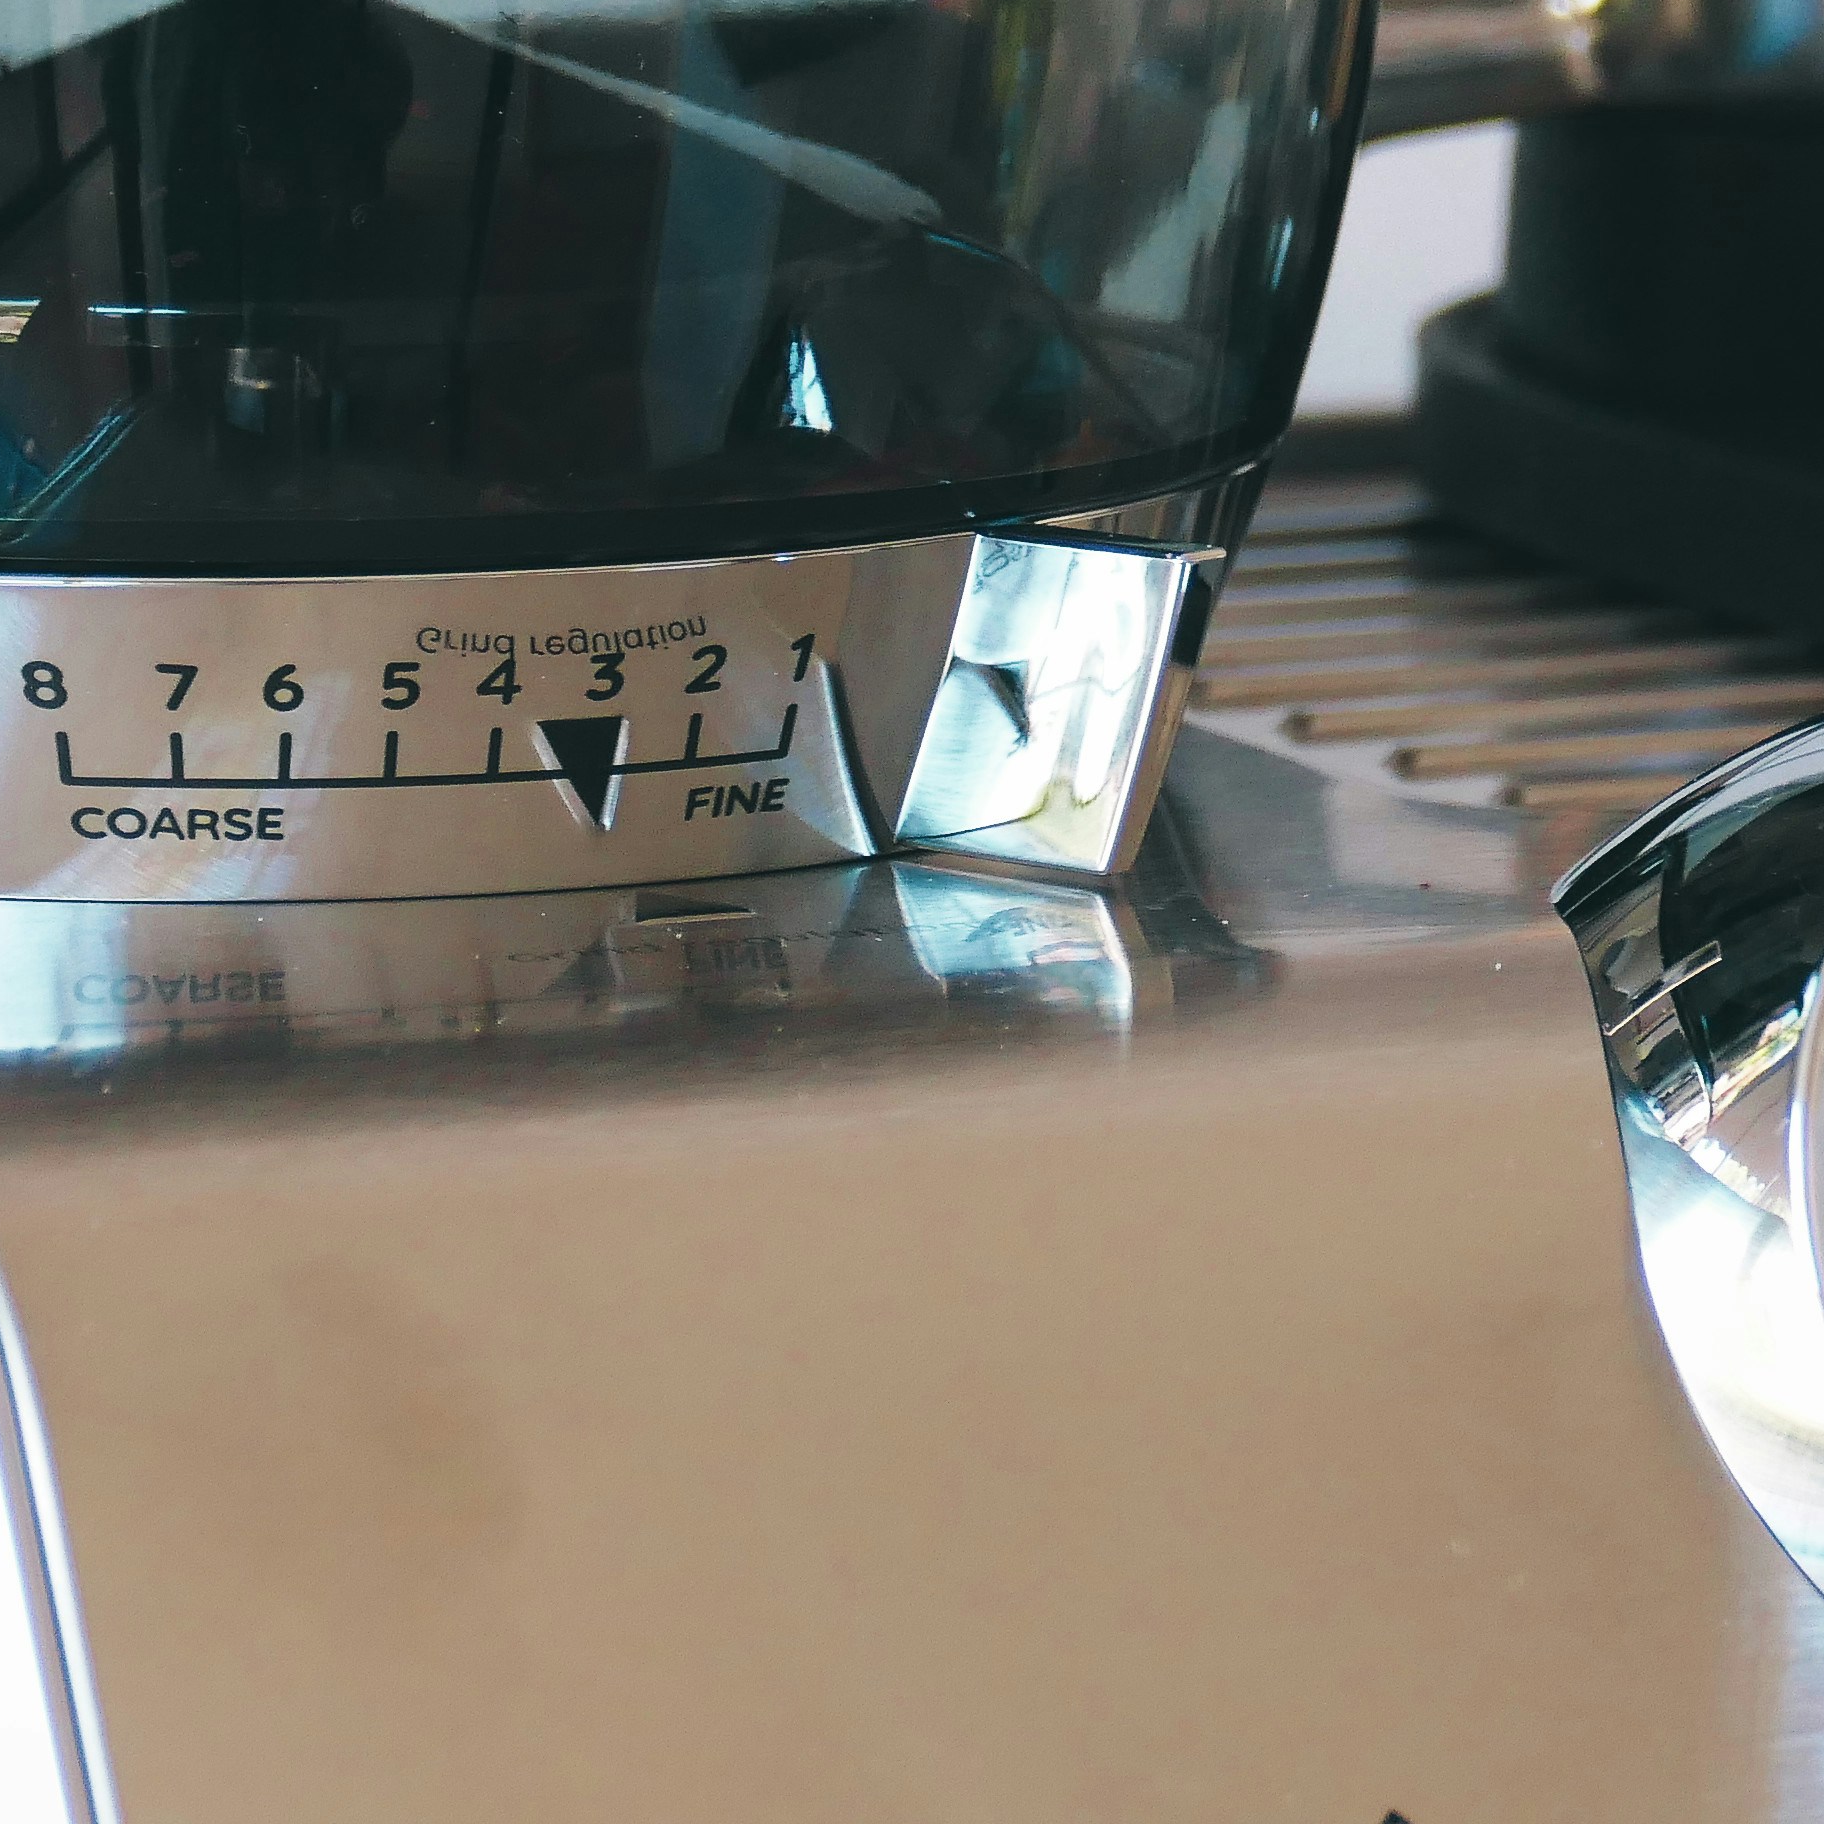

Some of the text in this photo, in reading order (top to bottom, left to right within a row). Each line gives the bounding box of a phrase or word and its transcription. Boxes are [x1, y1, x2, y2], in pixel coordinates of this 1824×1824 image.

[20, 632, 817, 713] 8 7 6 5 4 3 2 1
[683, 777, 790, 822] FINE
[70, 806, 286, 842] COARSE
